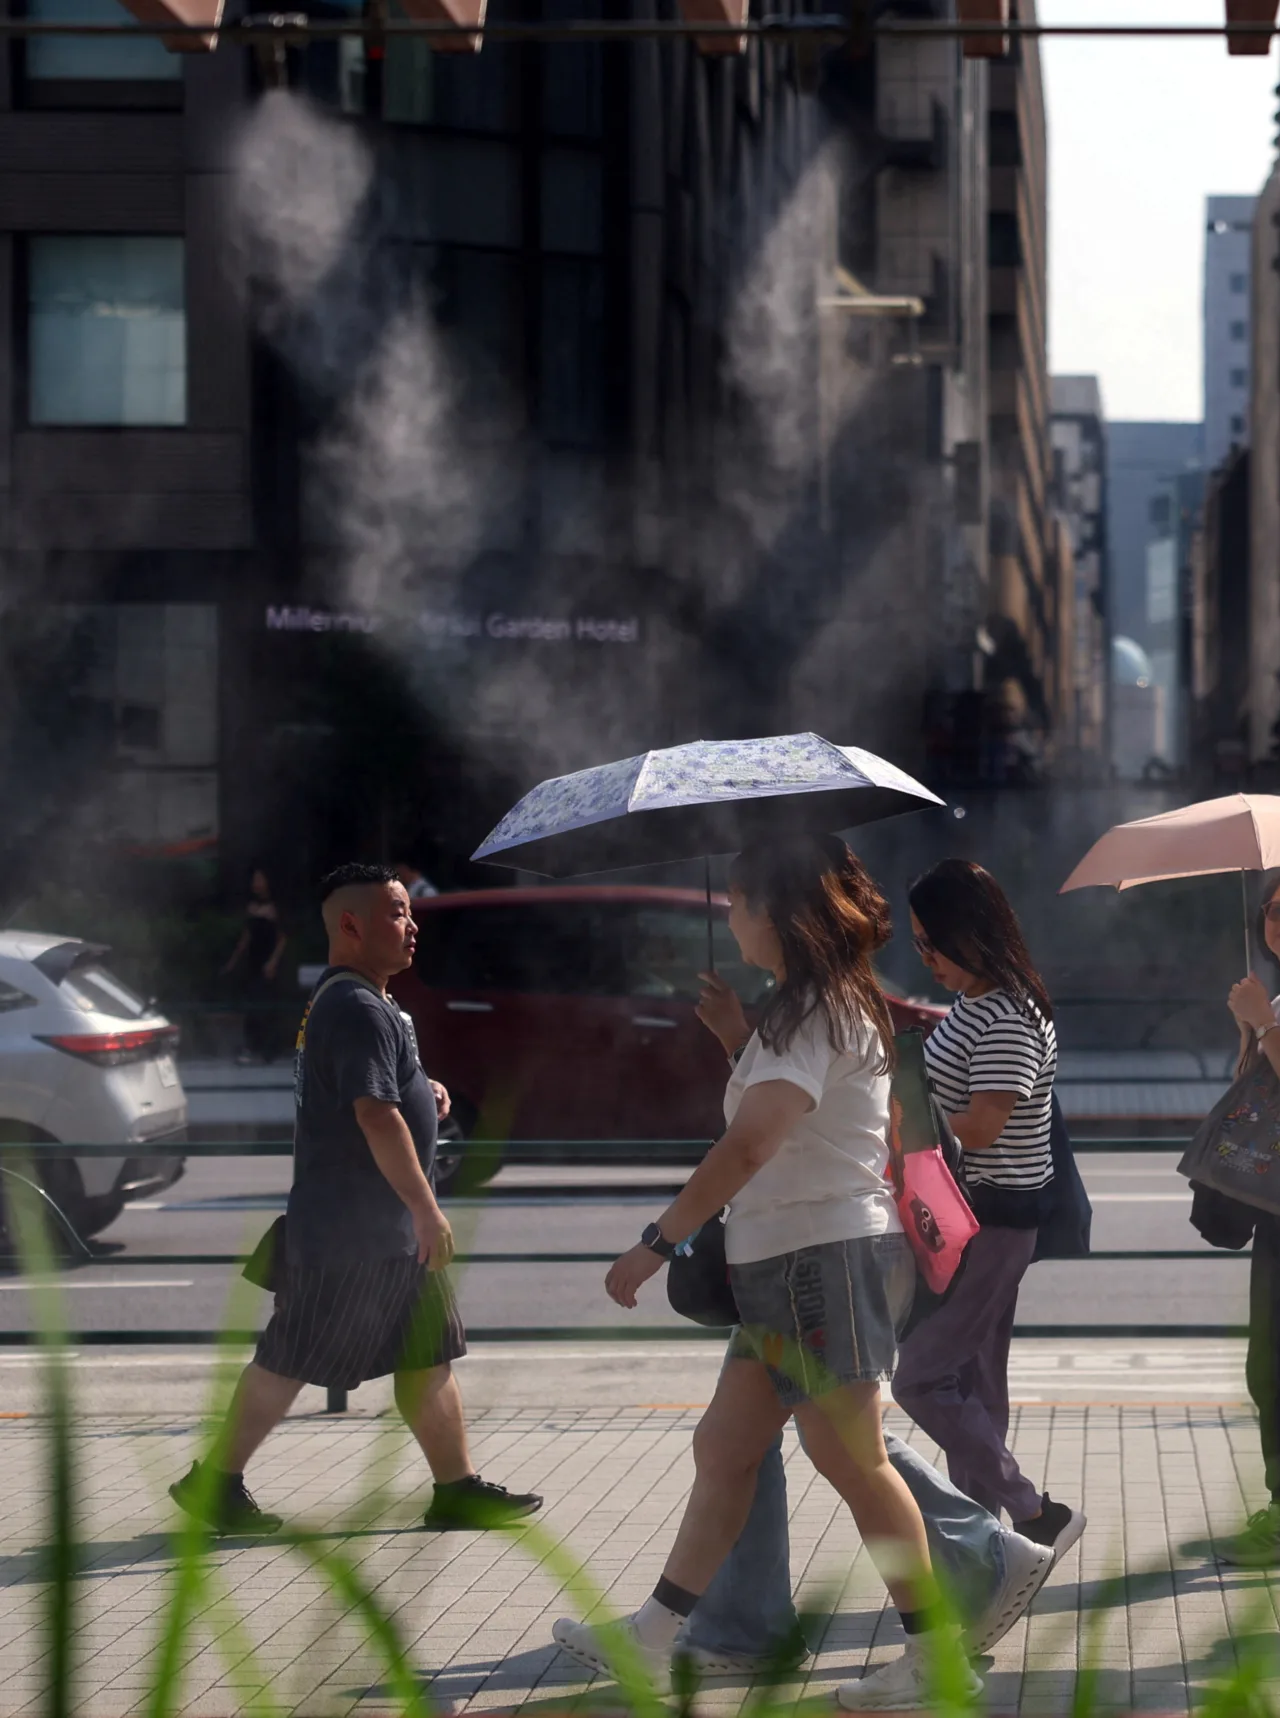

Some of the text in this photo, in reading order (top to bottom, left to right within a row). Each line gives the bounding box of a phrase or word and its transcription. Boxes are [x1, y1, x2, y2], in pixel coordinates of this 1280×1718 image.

[266, 605, 386, 633] Millenniu
[485, 612, 571, 640] Garden
[577, 615, 639, 642] Hotel
